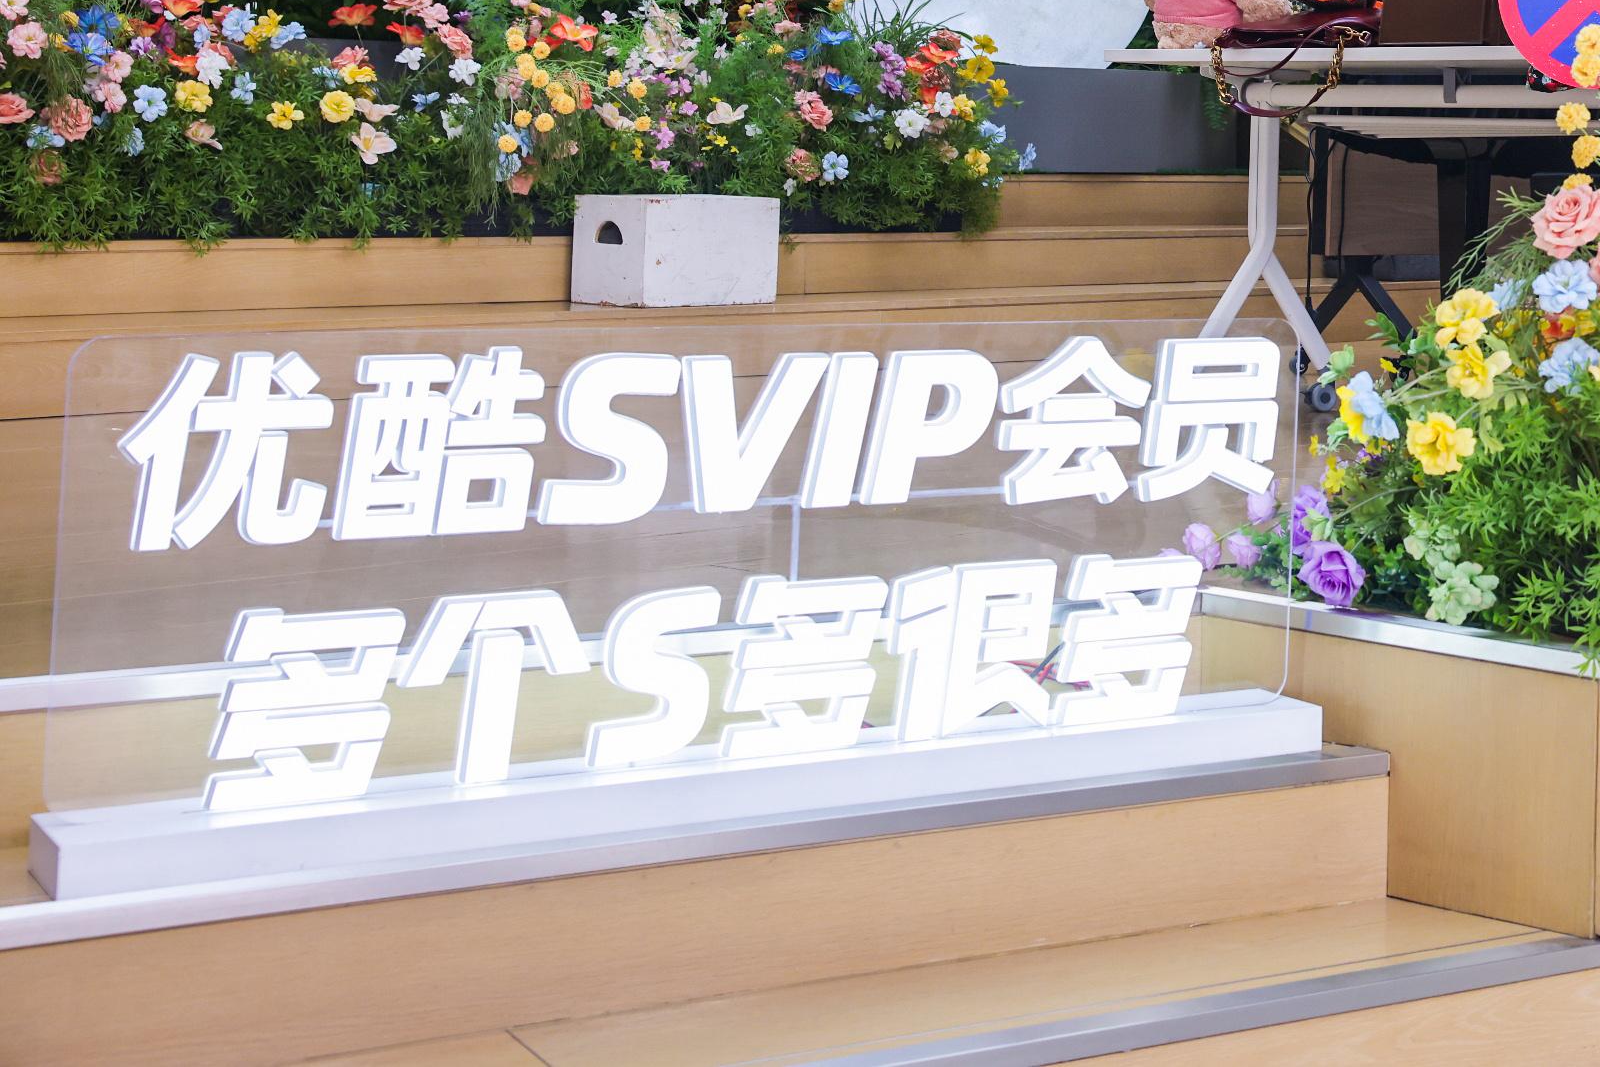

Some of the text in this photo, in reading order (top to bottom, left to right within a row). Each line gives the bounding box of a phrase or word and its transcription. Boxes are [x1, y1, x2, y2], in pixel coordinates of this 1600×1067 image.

[117, 332, 1283, 553] 优酷SVIP会员
[201, 553, 1204, 814] 多个S多很多
